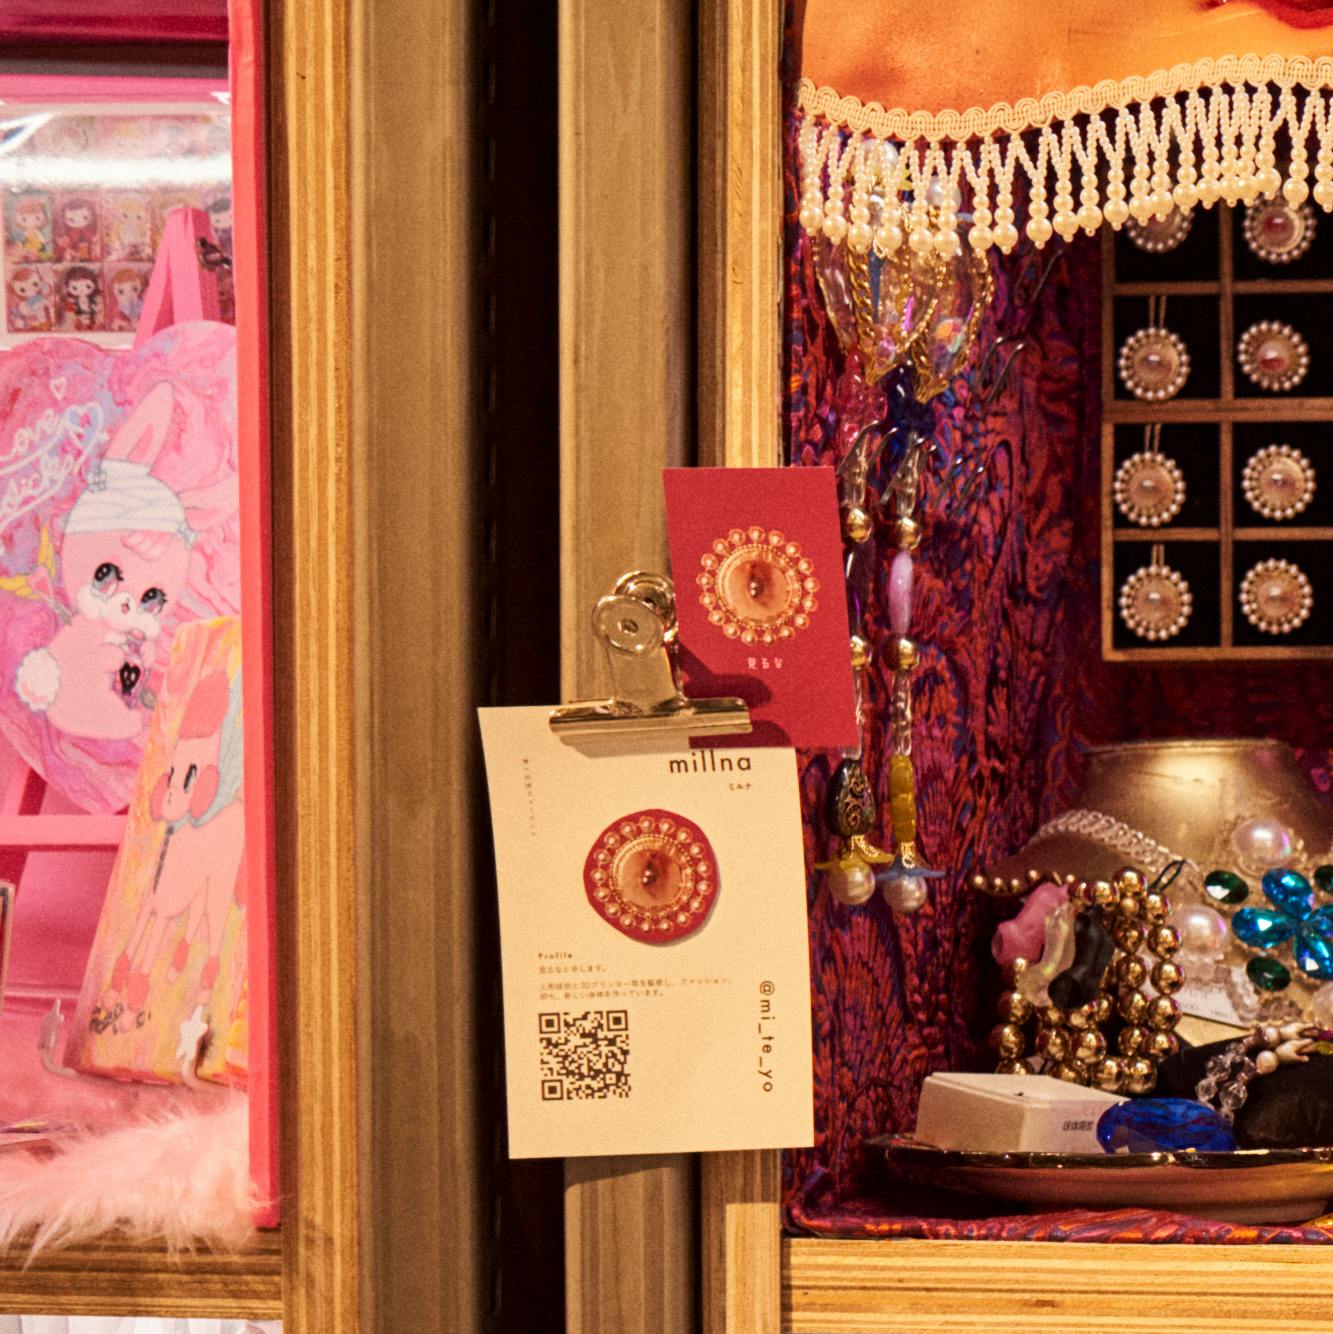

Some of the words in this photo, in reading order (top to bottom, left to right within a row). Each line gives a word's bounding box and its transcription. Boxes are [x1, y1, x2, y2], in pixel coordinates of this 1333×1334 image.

[669, 750, 752, 774] millna
[729, 781, 752, 791] ミルナ
[758, 980, 776, 1093] @mi_te_yo
